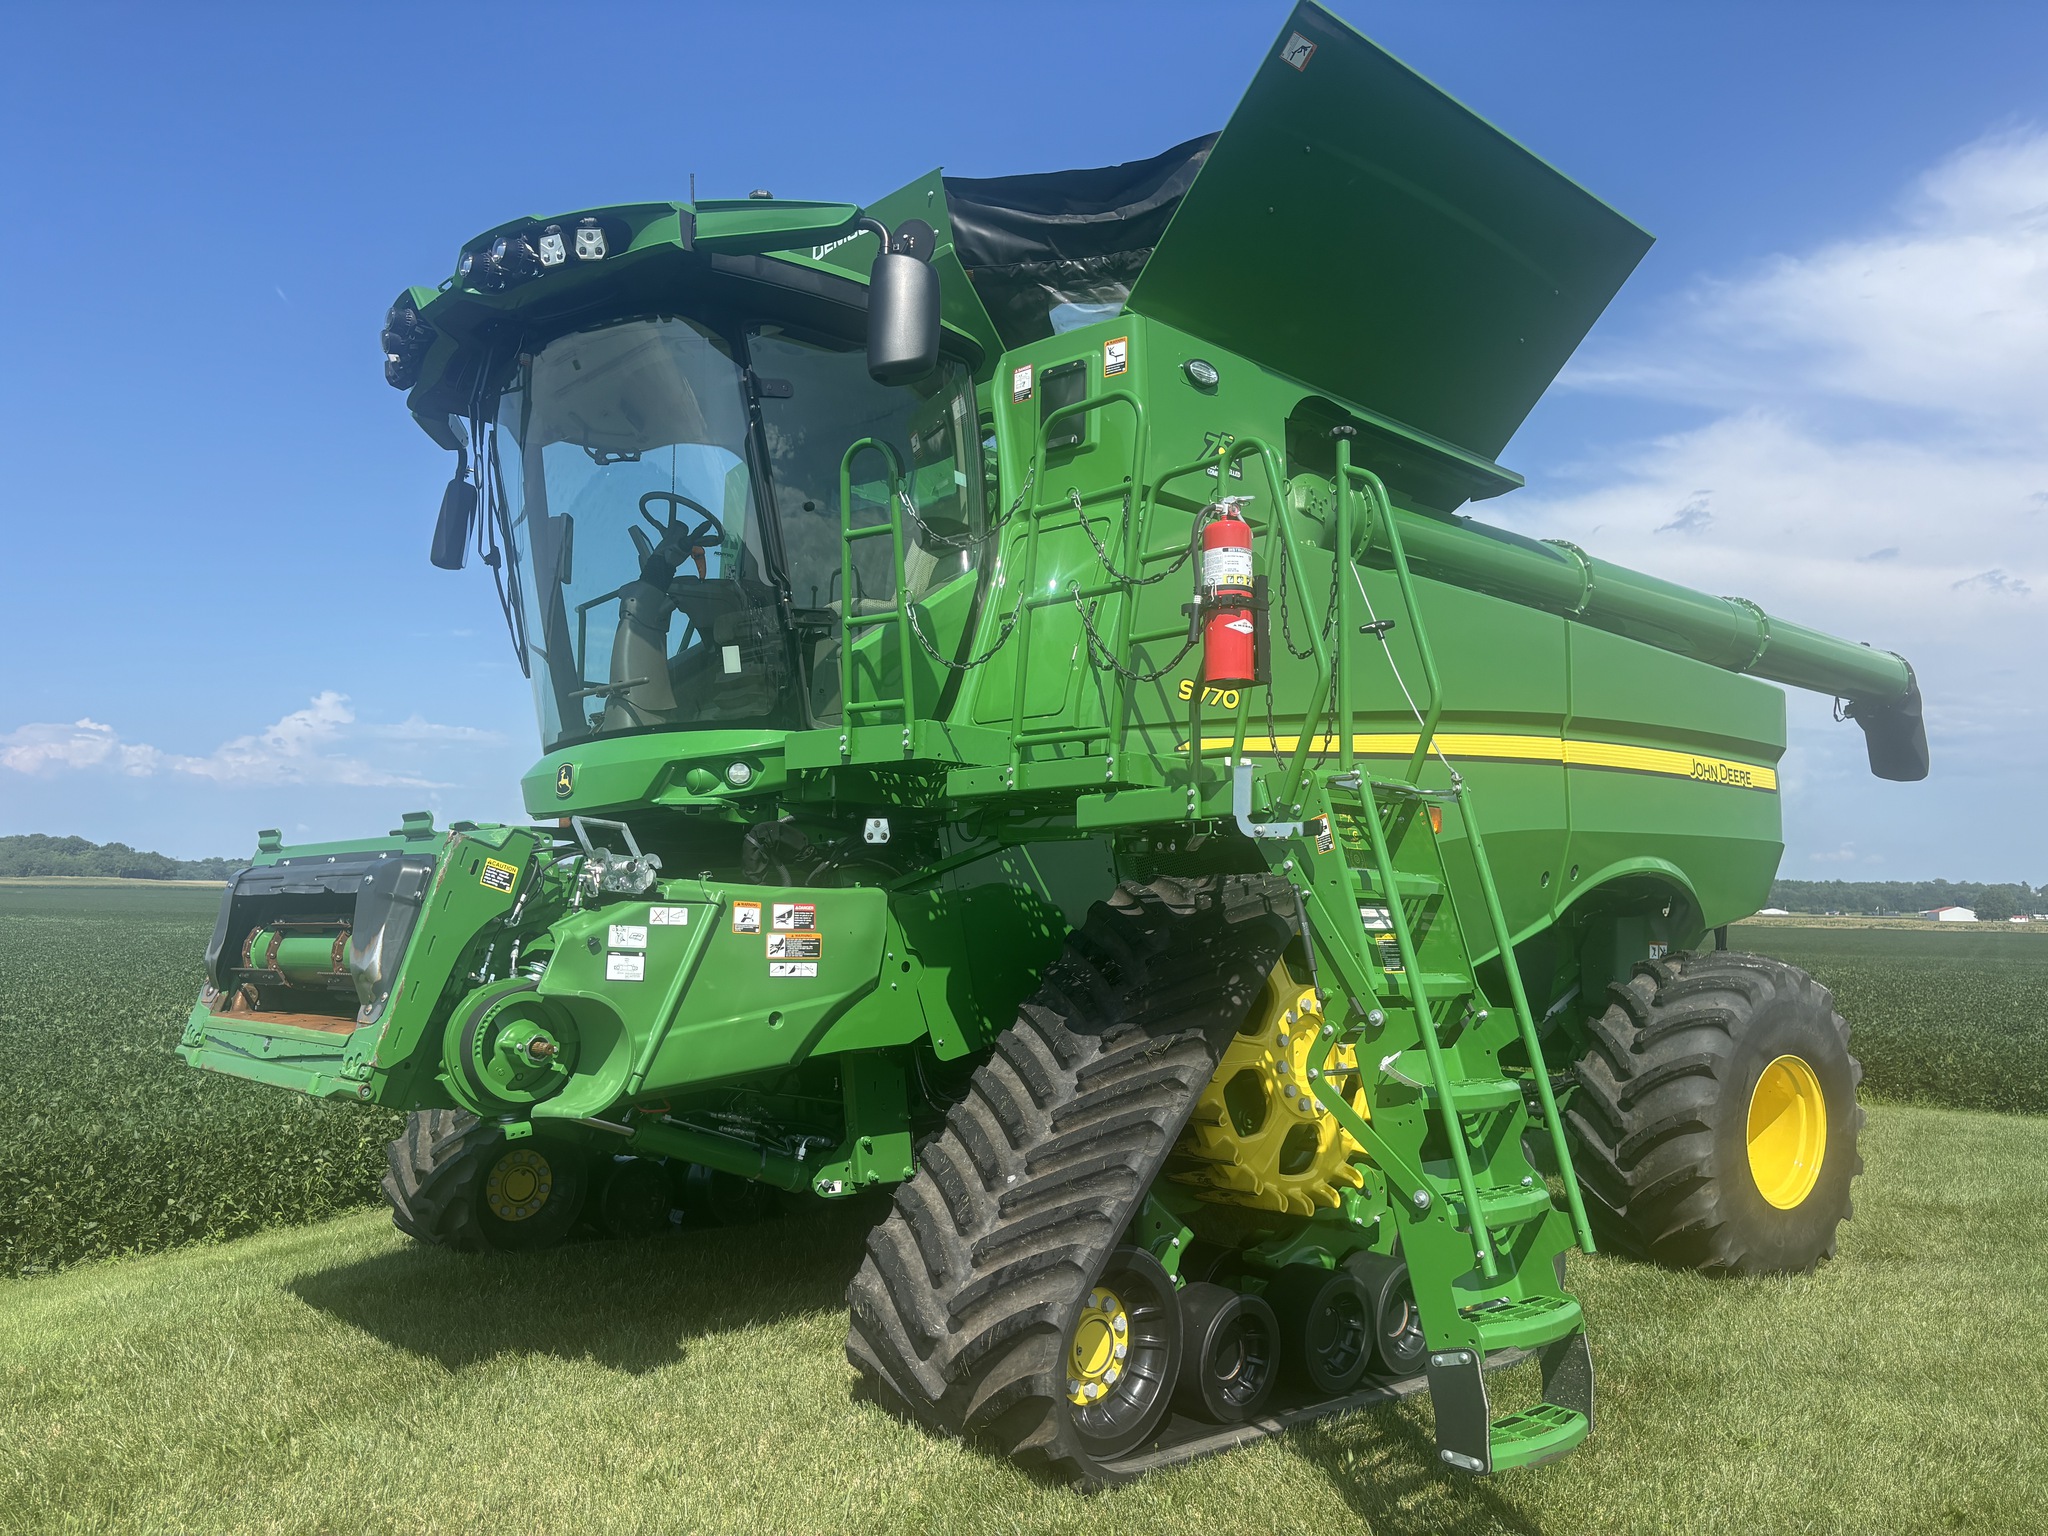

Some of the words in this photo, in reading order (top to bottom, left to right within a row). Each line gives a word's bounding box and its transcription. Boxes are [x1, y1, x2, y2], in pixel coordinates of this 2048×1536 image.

[1690, 758, 1717, 779] JOHN
[1719, 763, 1752, 785] DEERE
[491, 860, 517, 873] CAUTION
